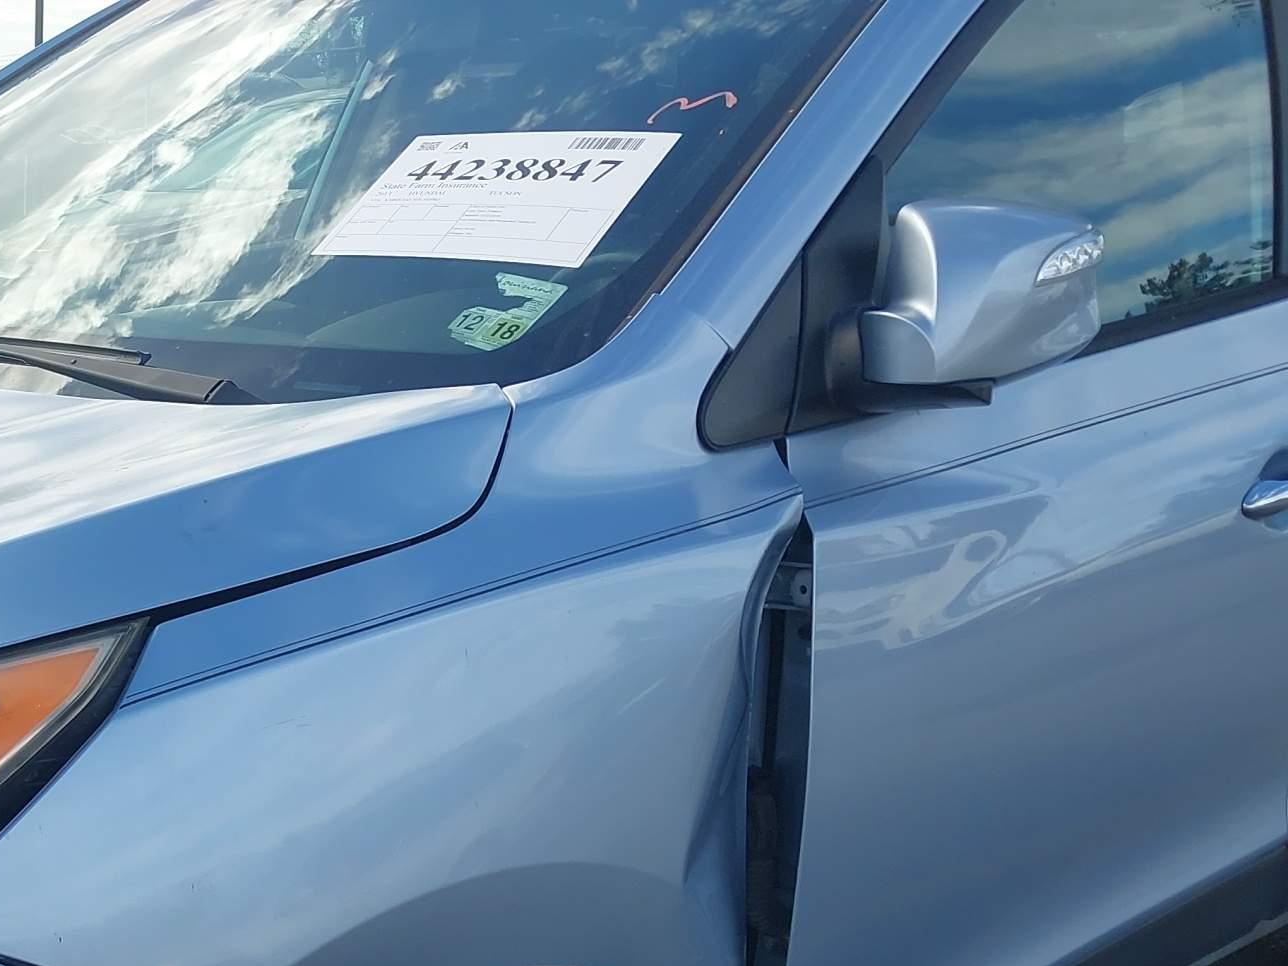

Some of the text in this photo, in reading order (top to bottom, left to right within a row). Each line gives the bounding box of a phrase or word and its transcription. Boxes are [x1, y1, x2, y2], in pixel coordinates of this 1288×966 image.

[407, 158, 624, 183] 44238847
[380, 182, 489, 190] State Farm Insurance
[457, 313, 483, 331] 12
[491, 322, 520, 339] 18
